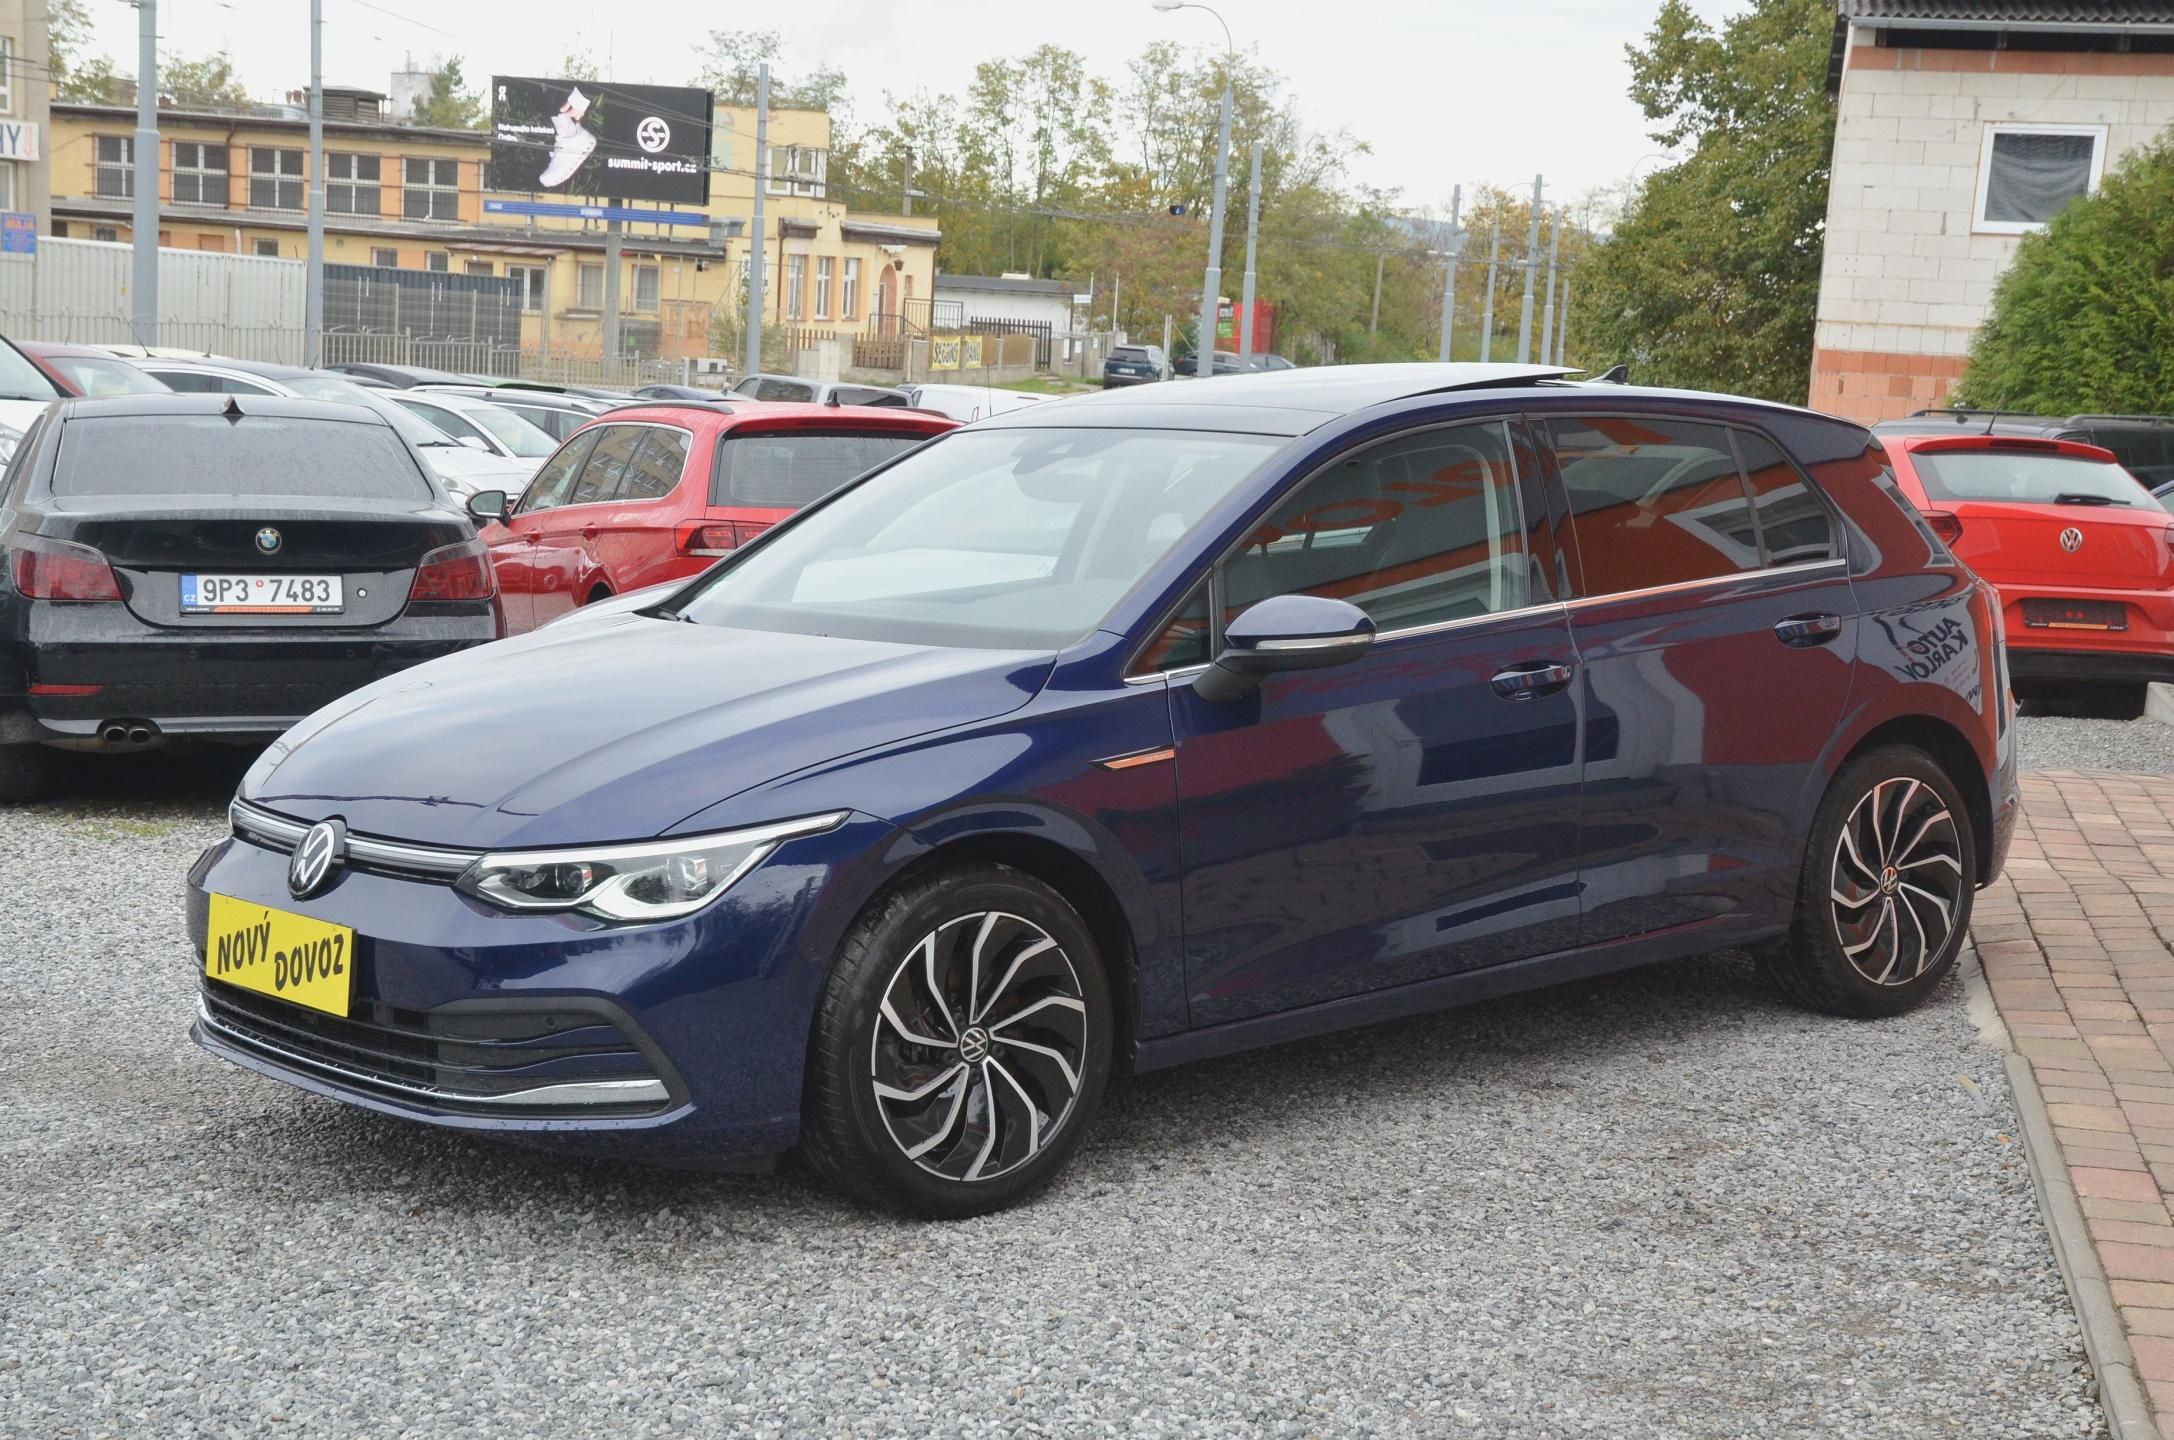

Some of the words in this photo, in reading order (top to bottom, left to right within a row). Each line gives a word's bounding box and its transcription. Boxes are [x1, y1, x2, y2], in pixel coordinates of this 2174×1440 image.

[0, 123, 21, 155] Y
[608, 157, 697, 174] summit-sport.cz
[183, 594, 197, 602] CZ
[203, 579, 249, 602] 9P3
[269, 579, 331, 602] 7483
[217, 910, 271, 975] NOVÝ
[274, 933, 345, 991] DOVOZ
